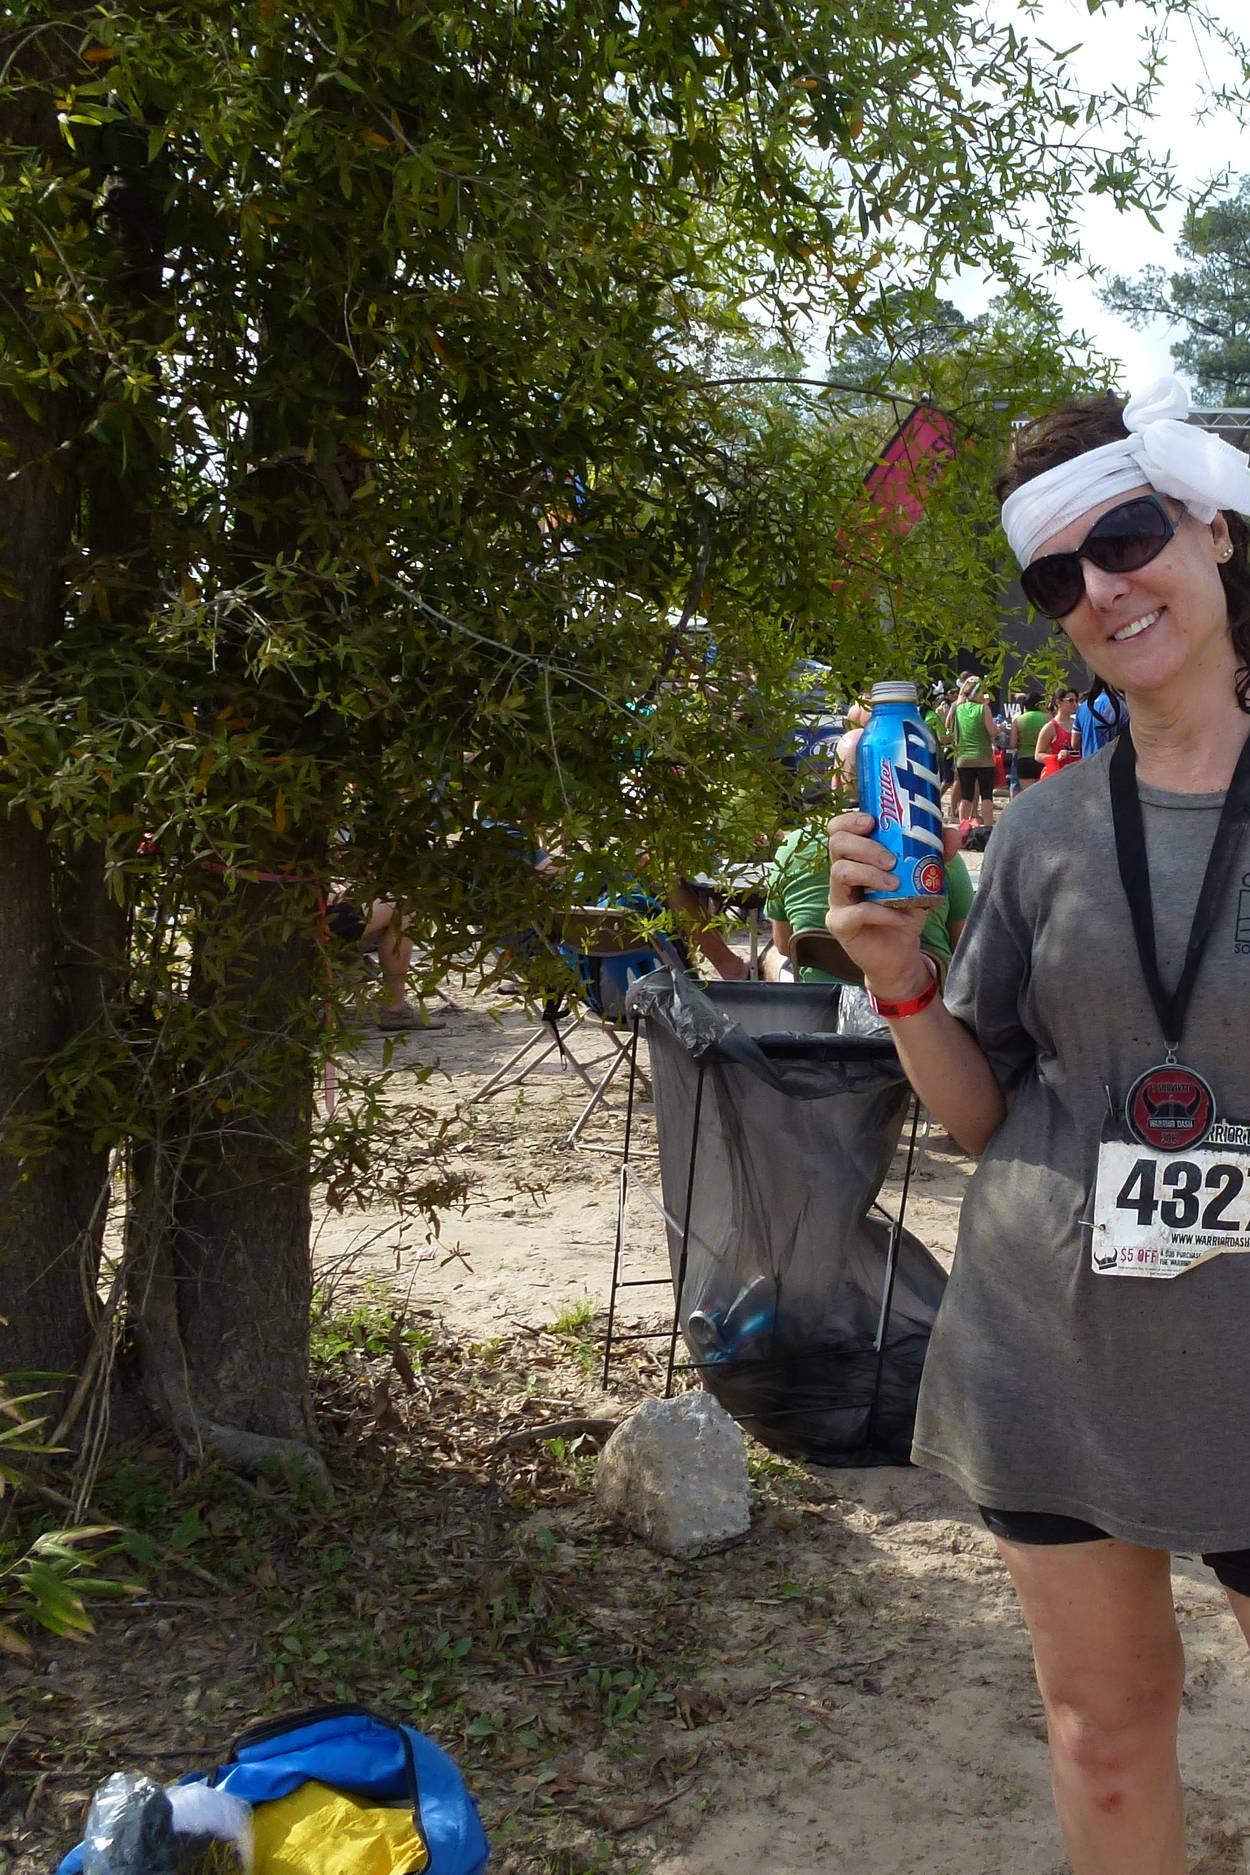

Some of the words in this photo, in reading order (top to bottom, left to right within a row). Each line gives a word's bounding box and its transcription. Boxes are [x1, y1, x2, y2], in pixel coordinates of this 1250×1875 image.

[879, 757, 901, 832] Miller
[1207, 1124, 1244, 1144] RRIOR
[1120, 1249, 1134, 1263] $5
[1138, 1250, 1157, 1264] OFF
